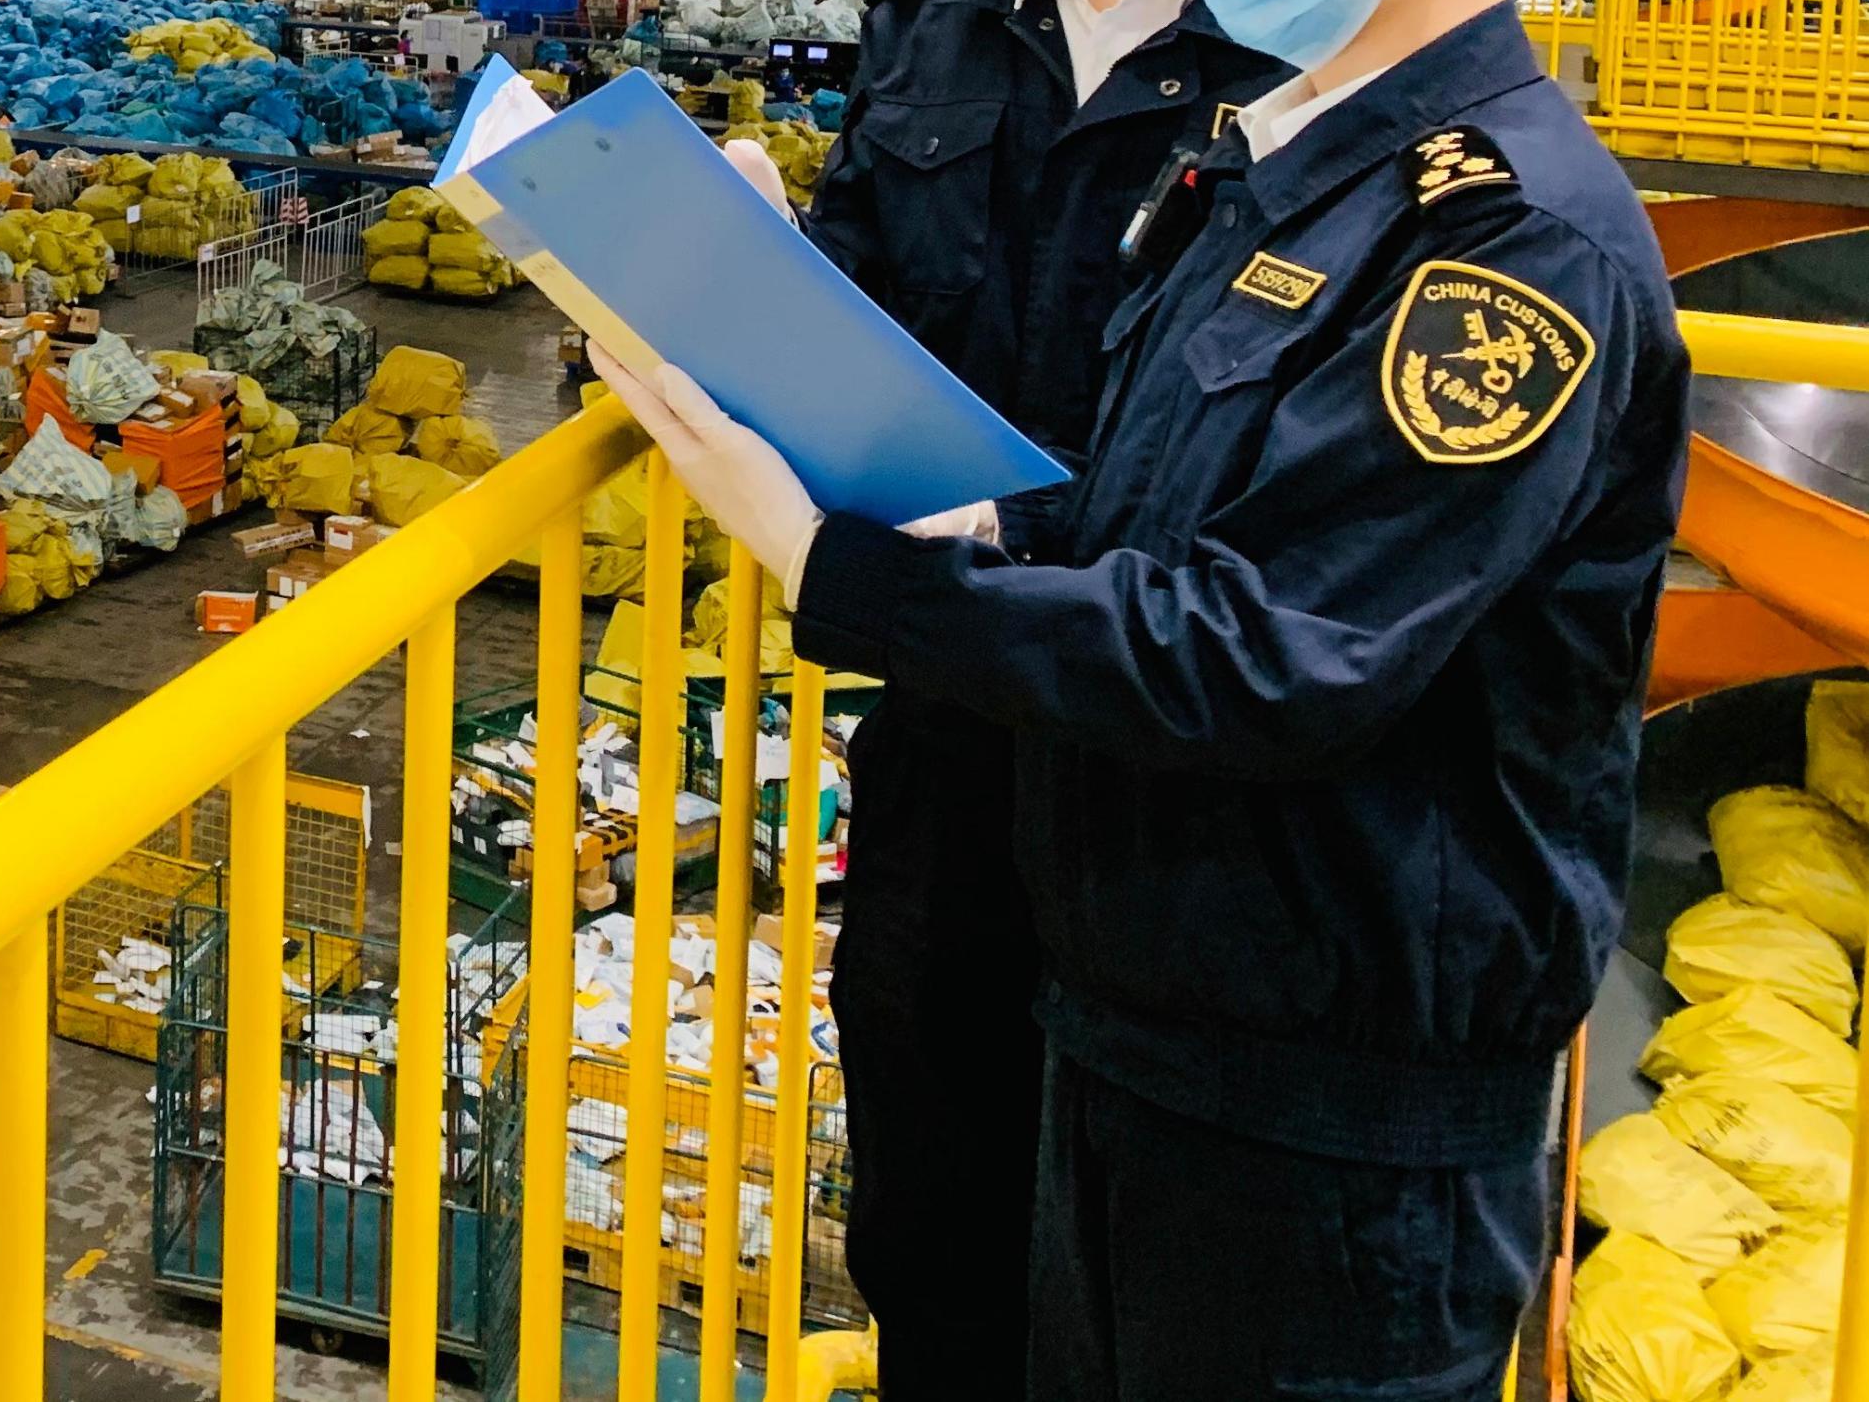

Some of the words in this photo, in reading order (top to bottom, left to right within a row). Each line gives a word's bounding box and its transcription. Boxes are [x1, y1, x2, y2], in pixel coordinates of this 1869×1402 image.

[1424, 282, 1491, 304] CHINA
[1494, 294, 1576, 372] CUSTOMS
[1431, 368, 1499, 418] 中国海关
